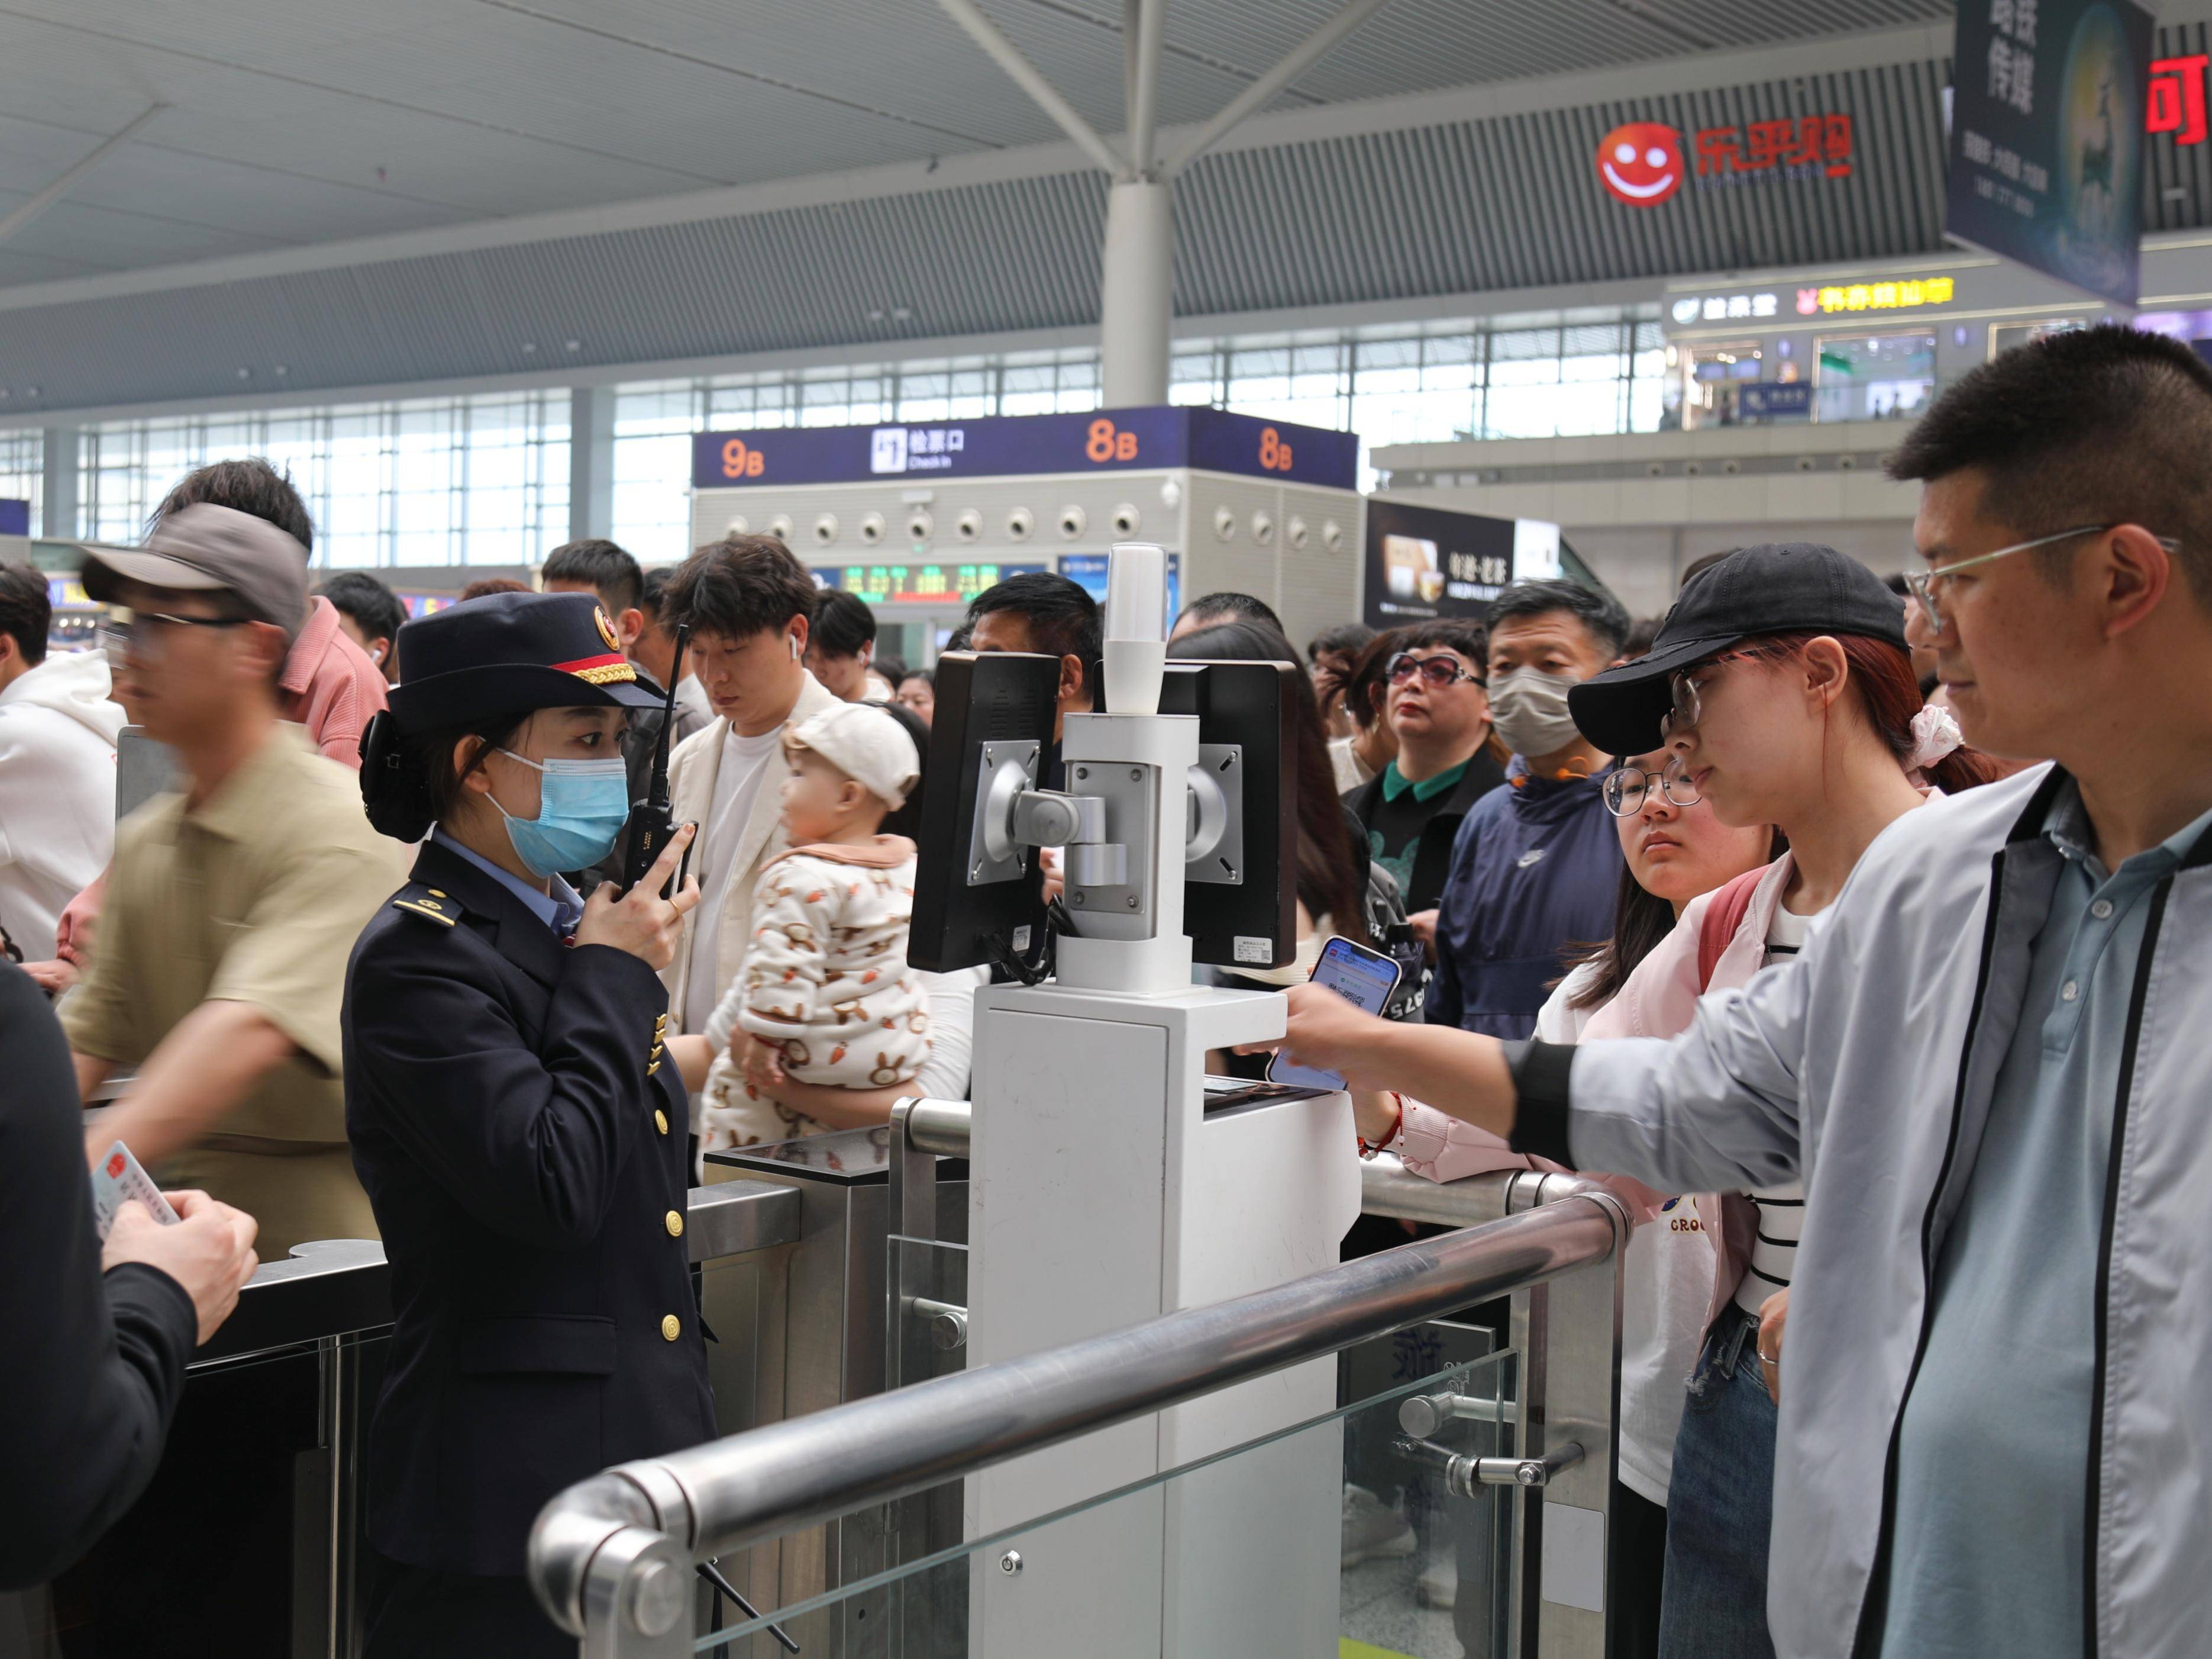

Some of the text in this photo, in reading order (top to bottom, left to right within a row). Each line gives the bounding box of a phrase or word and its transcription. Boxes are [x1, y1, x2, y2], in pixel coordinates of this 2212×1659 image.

[2146, 53, 2209, 147] 可
[721, 438, 765, 479] 9B
[908, 428, 965, 454] 检票口
[1085, 418, 1138, 463] 8B
[1259, 426, 1293, 471] 8B
[908, 455, 940, 470] Check
